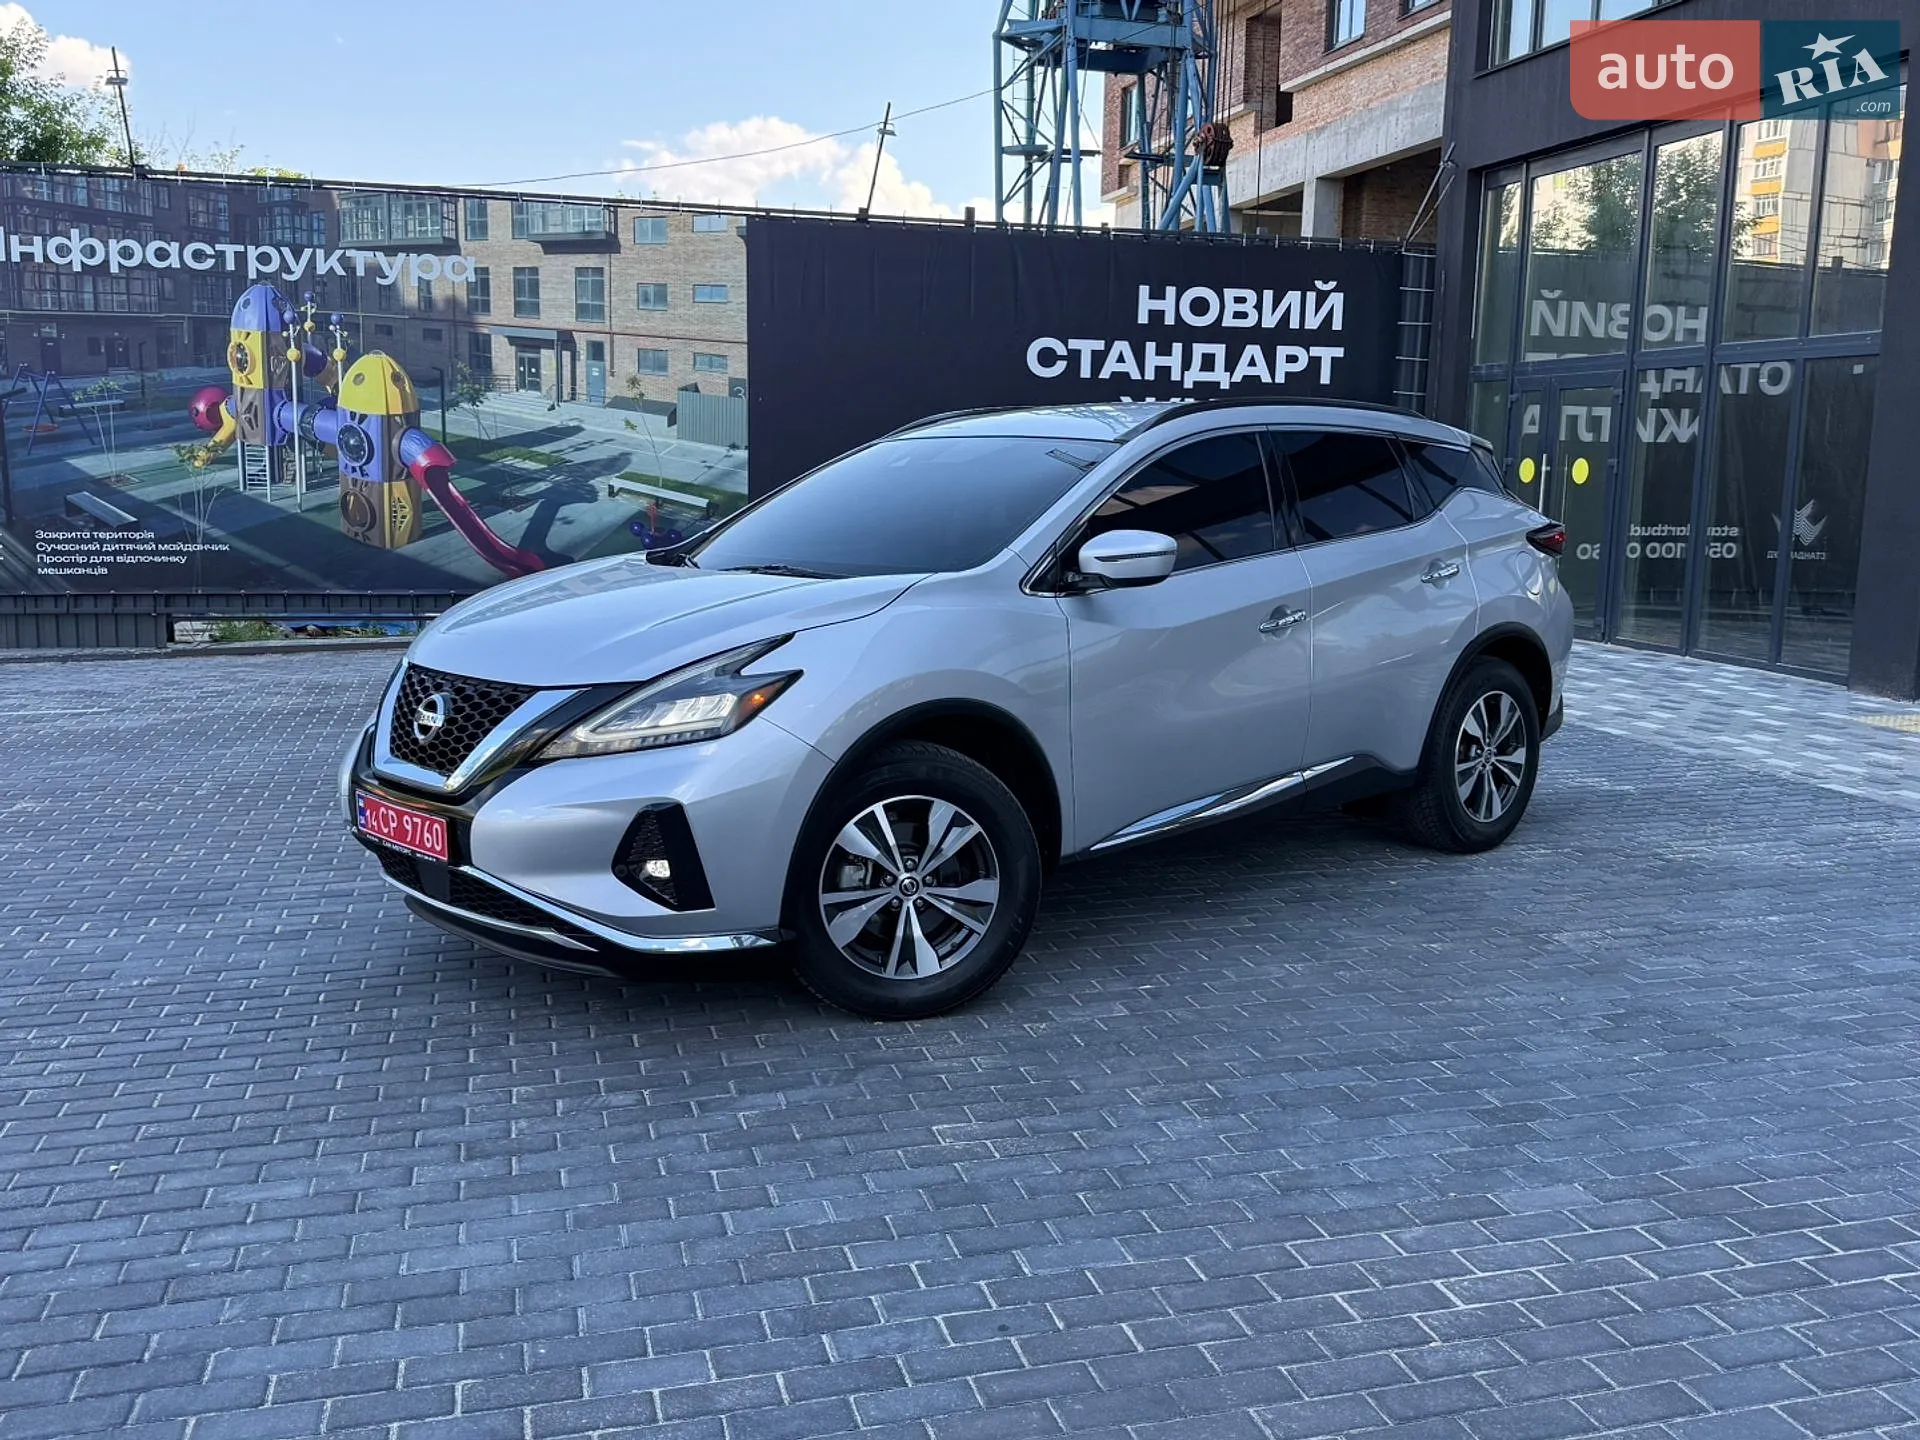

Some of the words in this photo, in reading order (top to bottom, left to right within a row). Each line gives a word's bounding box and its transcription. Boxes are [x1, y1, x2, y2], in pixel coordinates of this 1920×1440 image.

[1137, 280, 1344, 330] НОВИЙ
[1026, 337, 1344, 389] СТАНДАРТ
[35, 529, 91, 540] Закрита
[92, 529, 155, 540] територія
[36, 541, 101, 552] Сучасний
[102, 541, 156, 552] дитячий
[157, 541, 230, 552] майданчик
[37, 553, 88, 564] Простір
[89, 555, 115, 564] для
[116, 553, 188, 564] відпочинку
[37, 565, 108, 576] мешканців
[402, 814, 443, 852] 9760
